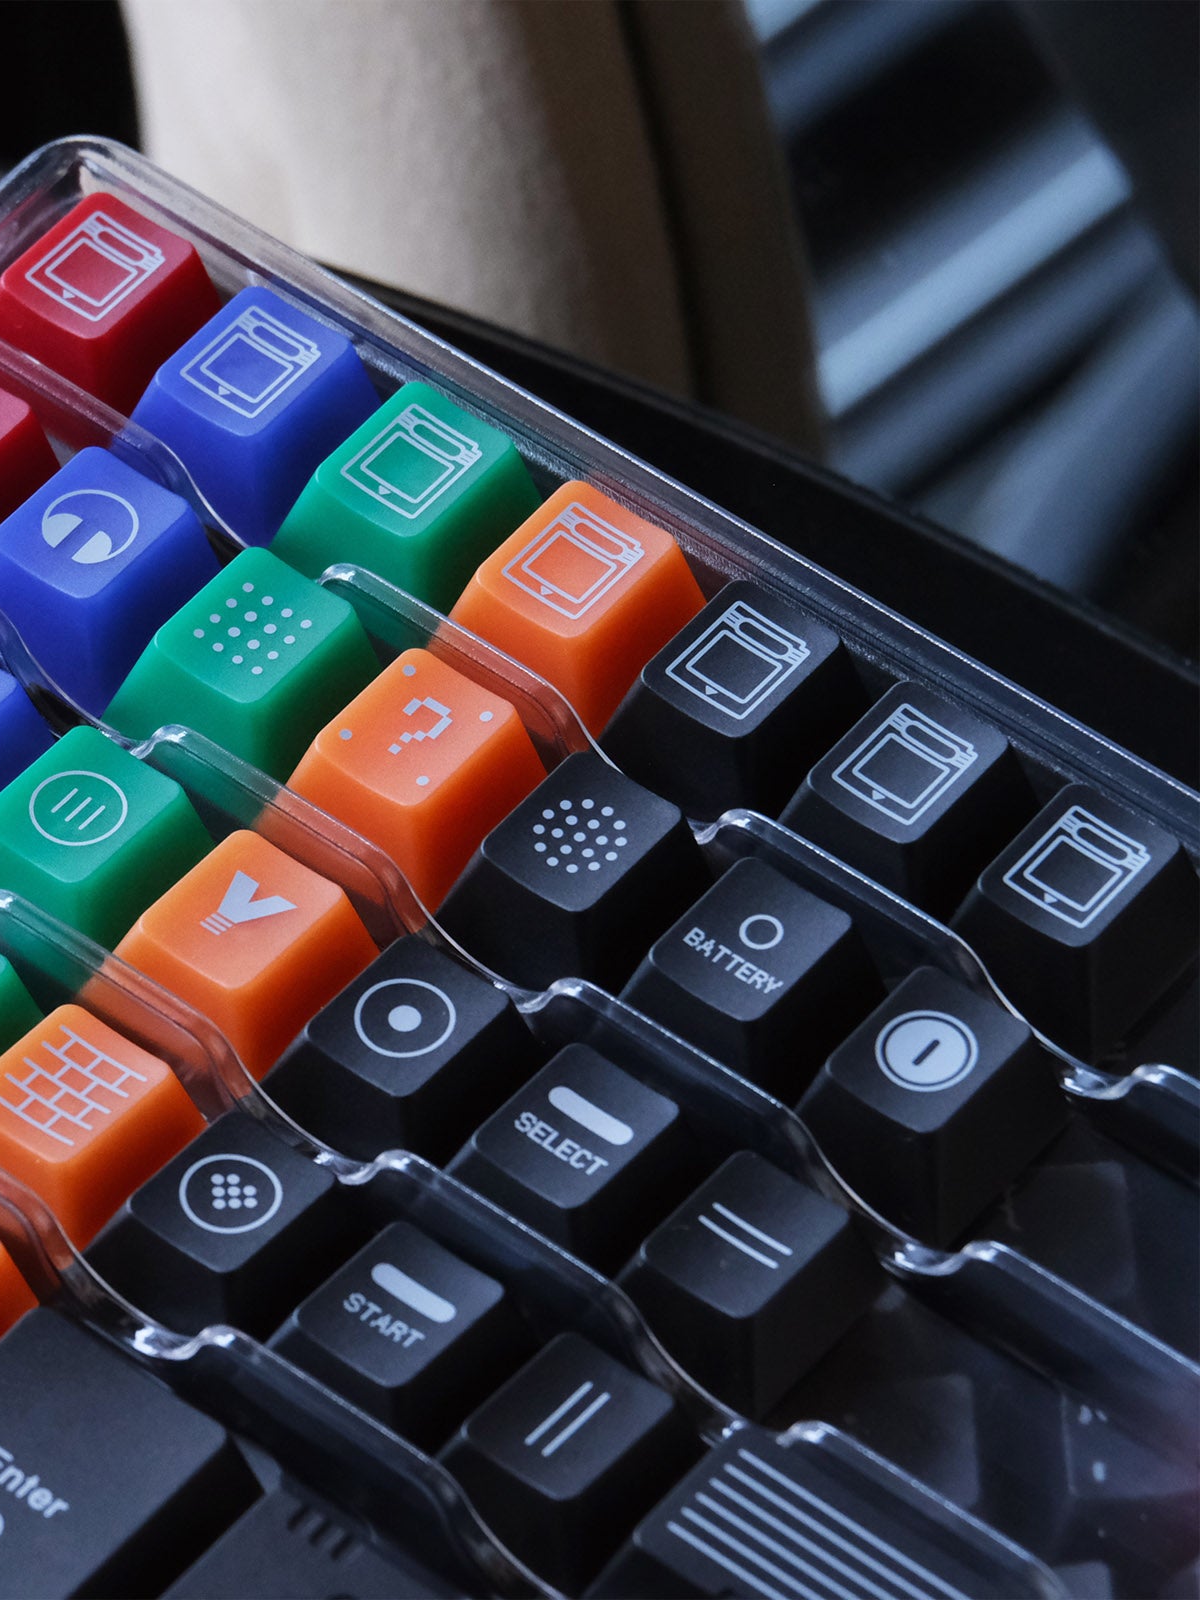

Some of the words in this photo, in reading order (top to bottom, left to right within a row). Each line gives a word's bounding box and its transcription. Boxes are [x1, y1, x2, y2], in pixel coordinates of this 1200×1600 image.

[200, 870, 298, 935] Y
[683, 926, 784, 994] BATTERY
[514, 1111, 609, 1176] SELECT
[343, 1292, 426, 1348] START
